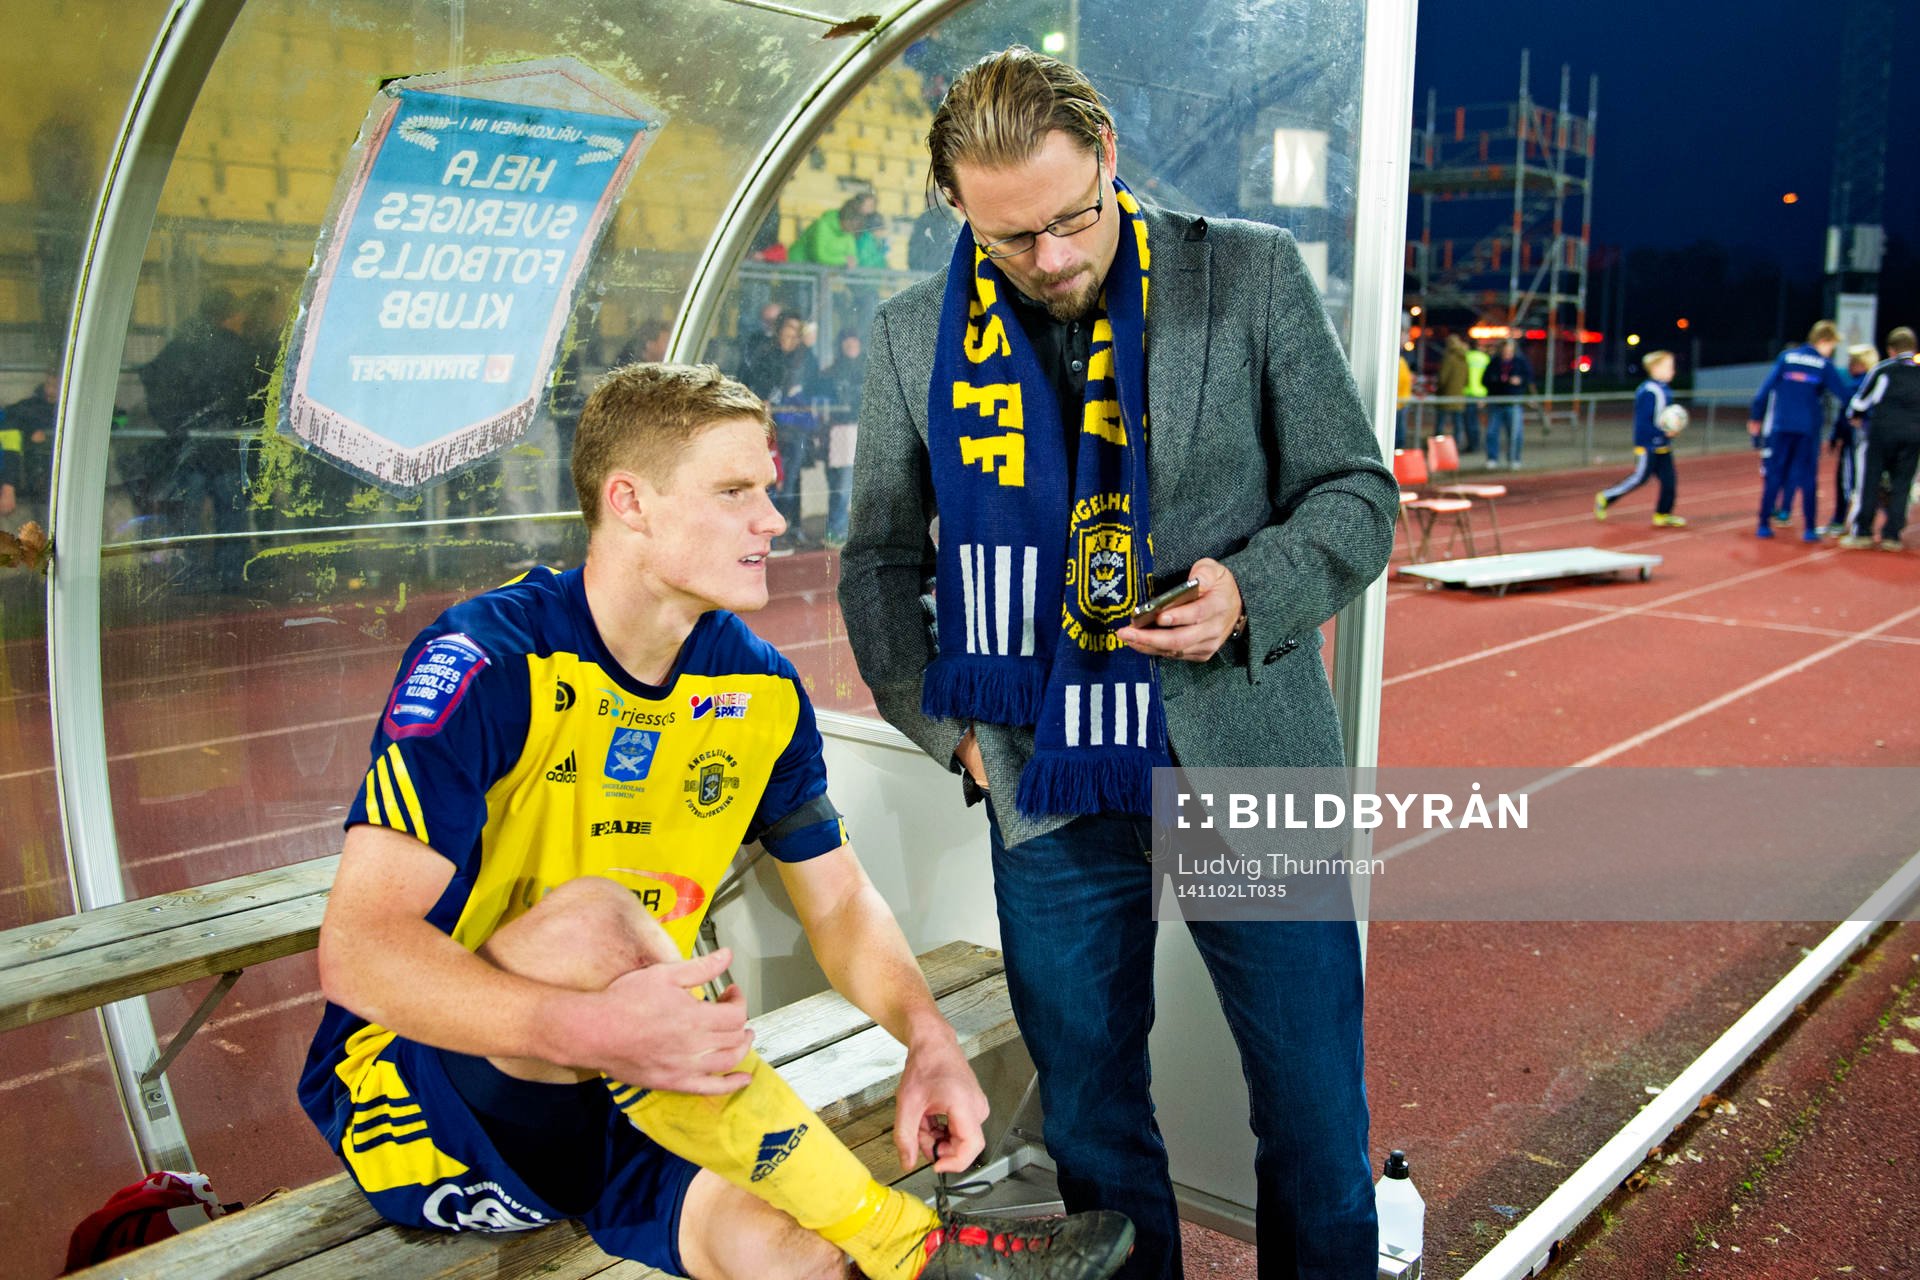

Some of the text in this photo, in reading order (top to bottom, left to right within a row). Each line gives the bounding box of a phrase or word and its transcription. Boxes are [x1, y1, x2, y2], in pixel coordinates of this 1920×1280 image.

[429, 653, 457, 666] HELA
[405, 685, 439, 701] KLUBB
[714, 705, 747, 718] SPORT
[751, 1123, 809, 1183] adidas
